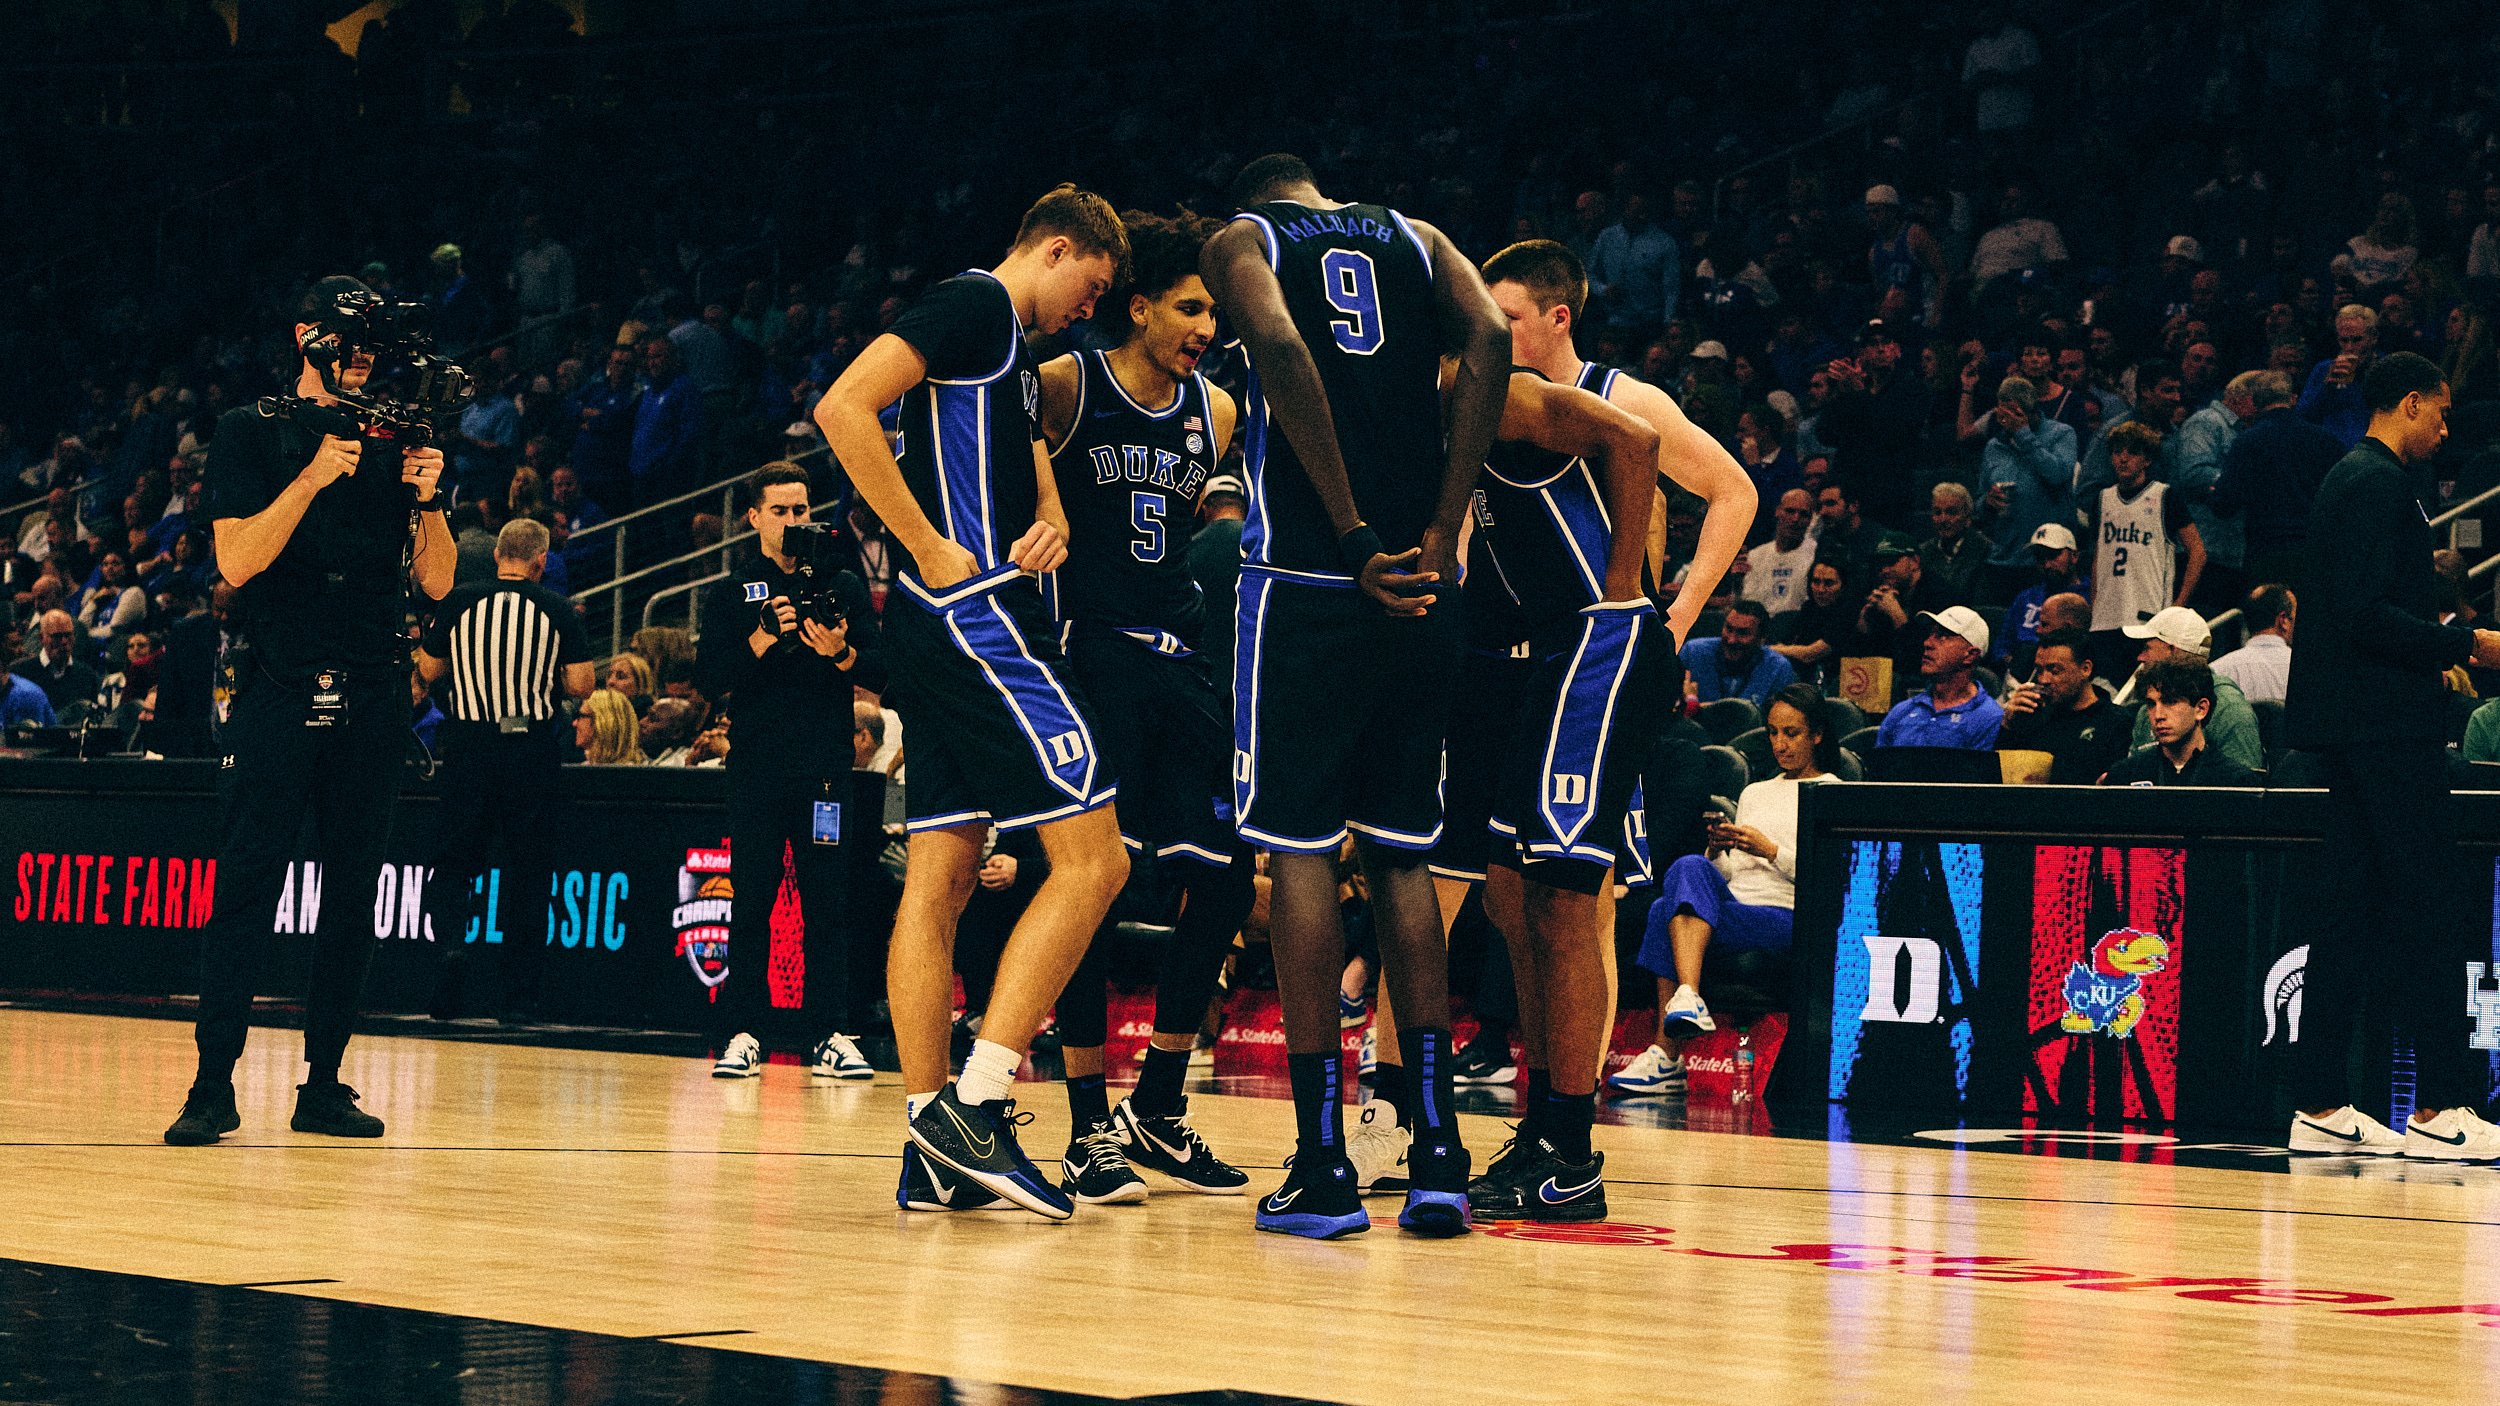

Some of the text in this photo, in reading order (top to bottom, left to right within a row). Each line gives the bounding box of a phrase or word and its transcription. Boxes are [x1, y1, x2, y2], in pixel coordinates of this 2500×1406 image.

[1280, 214, 1394, 243] MALUACH
[1321, 247, 1385, 356] 9
[300, 327, 319, 345] ONIN
[1089, 444, 1207, 500] DUKE
[1131, 490, 1166, 563] 5
[2104, 521, 2153, 546] Duke
[2112, 547, 2128, 576] 2
[1048, 730, 1084, 766] D
[1553, 774, 1585, 805] D
[14, 851, 114, 923] STATE
[122, 855, 216, 928] FARM
[672, 899, 732, 929] CHAMPI
[685, 928, 729, 942] CLASS
[2090, 985, 2117, 1007] KU
[1686, 1054, 1735, 1074] StateFa
[1538, 1138, 1555, 1154] CFOST
